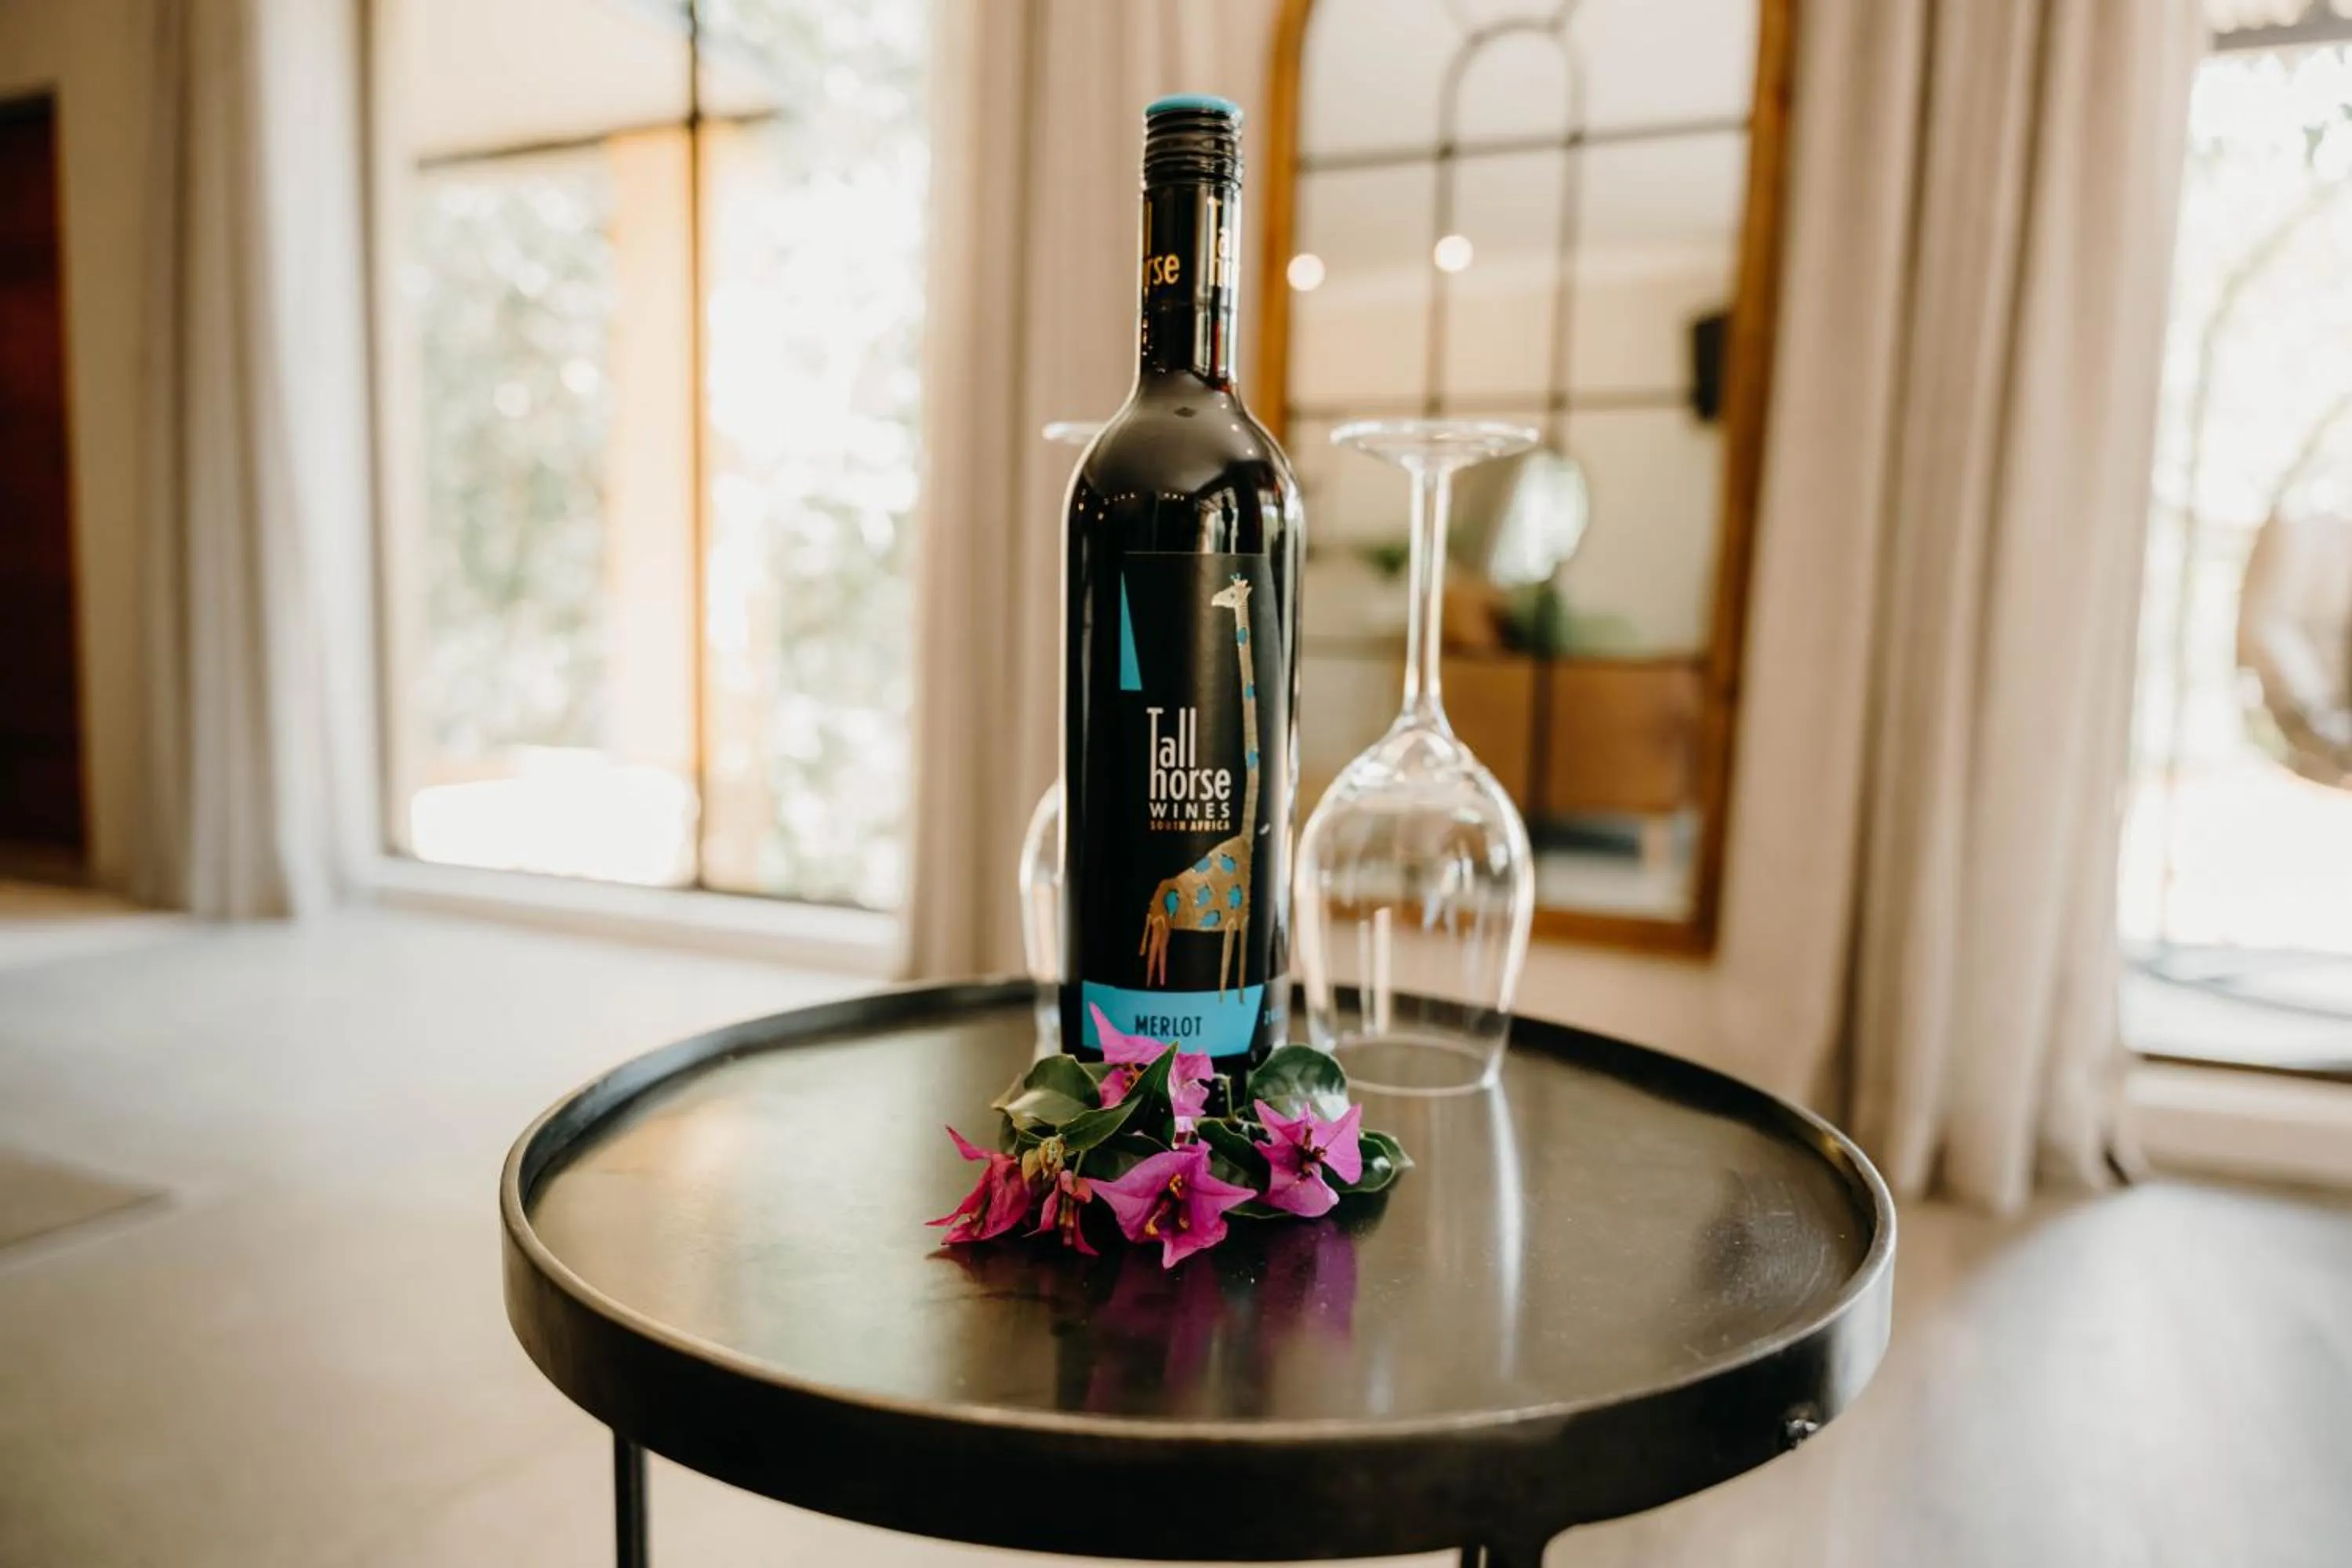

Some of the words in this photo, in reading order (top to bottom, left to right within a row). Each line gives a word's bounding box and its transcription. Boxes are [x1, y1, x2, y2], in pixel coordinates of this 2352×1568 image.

[1145, 254, 1180, 286] rse
[1146, 706, 1197, 769] Tall
[1149, 768, 1232, 800] horse
[1149, 801, 1231, 818] WINES
[1189, 820, 1231, 831] AFRICA
[1134, 1014, 1203, 1037] MERLOT
